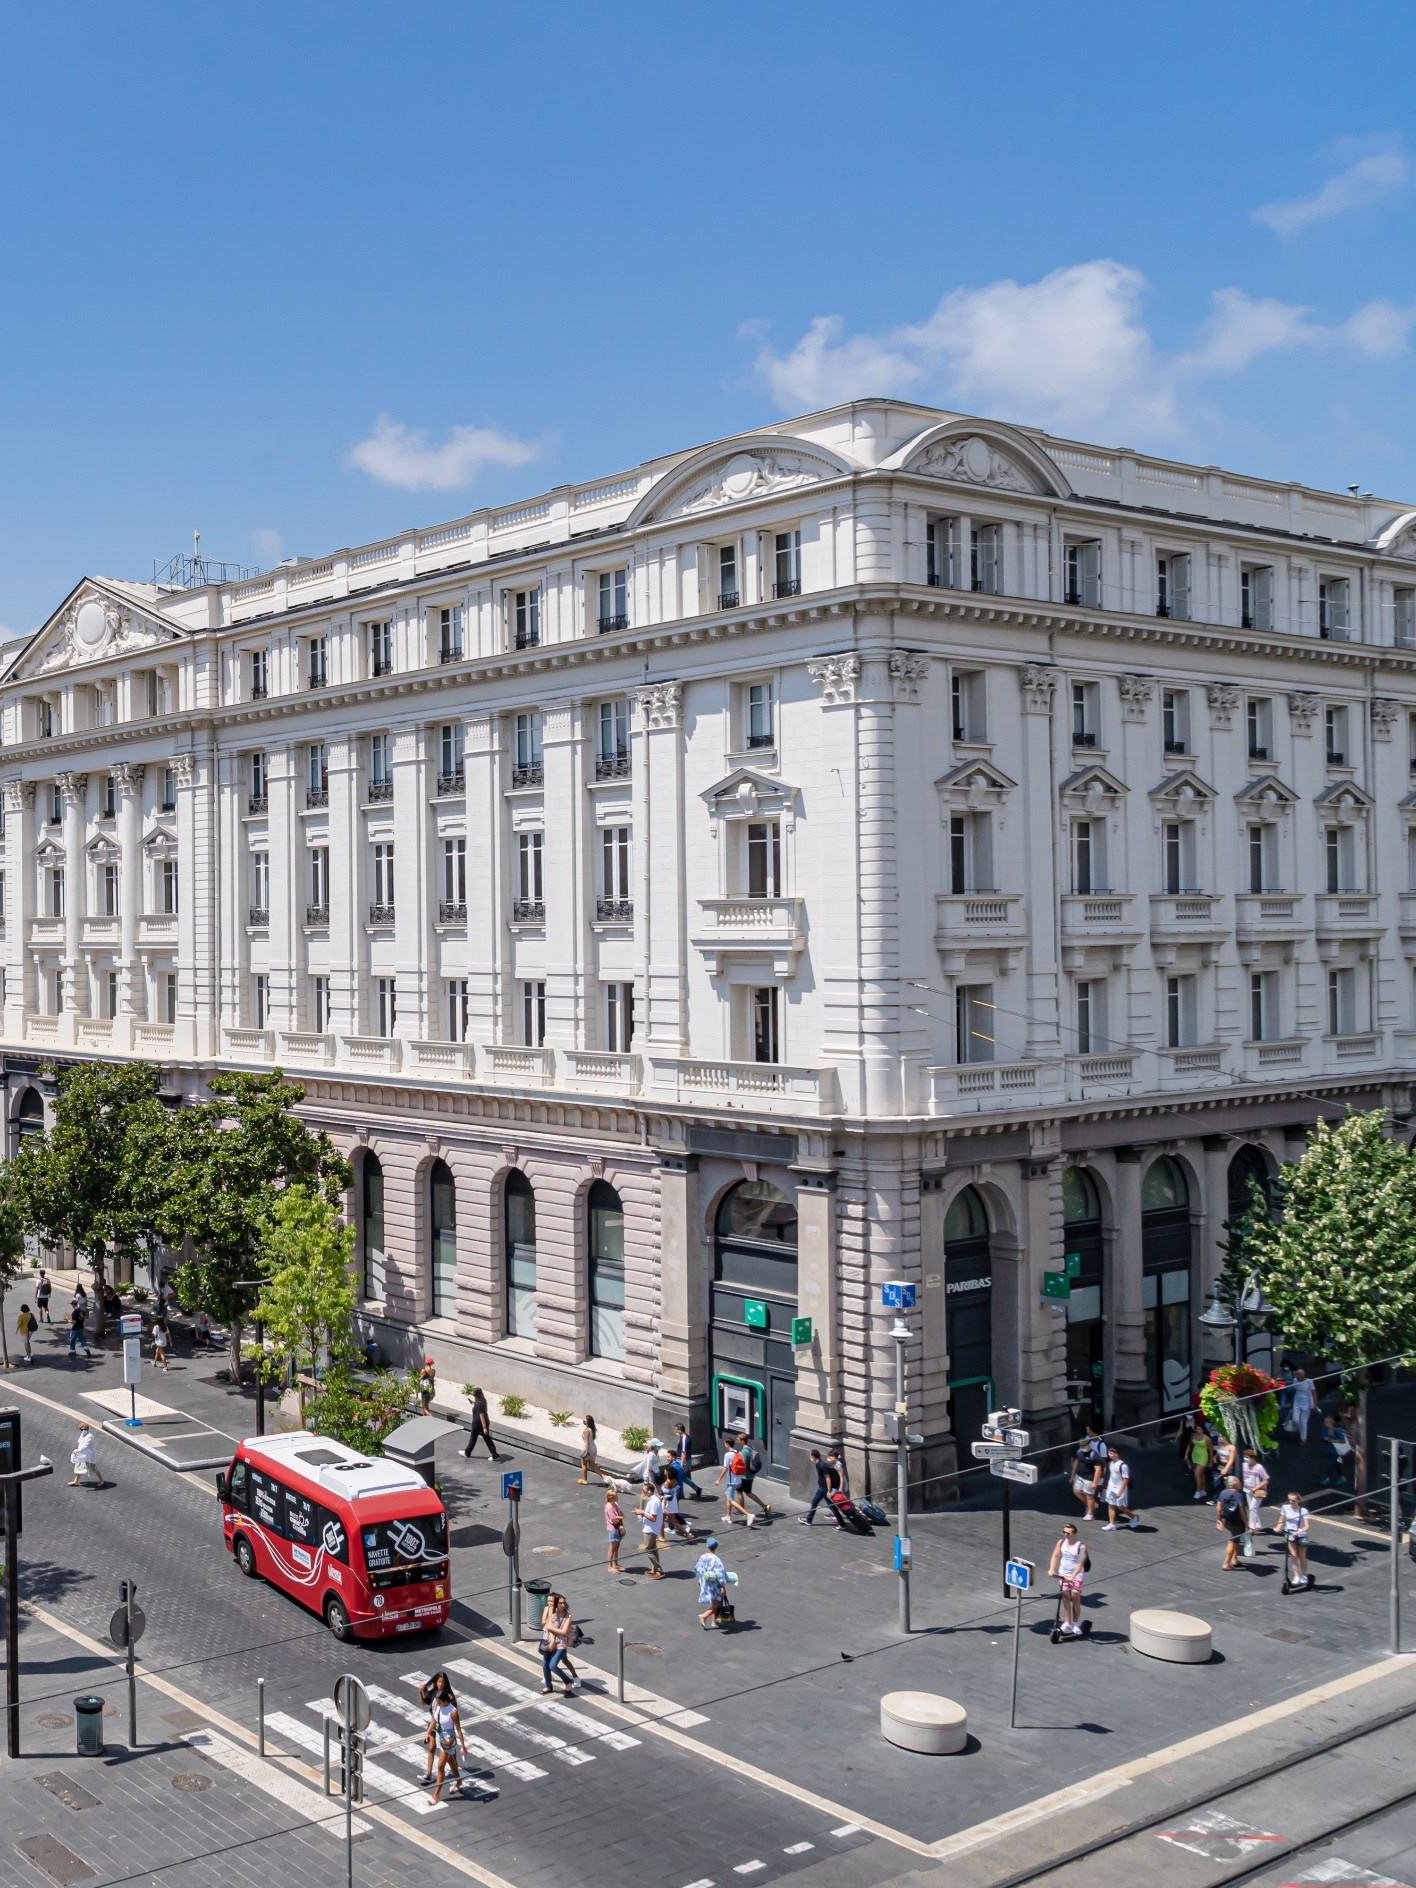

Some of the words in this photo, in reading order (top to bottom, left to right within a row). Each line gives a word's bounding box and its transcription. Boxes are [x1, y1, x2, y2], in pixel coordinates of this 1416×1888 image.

[946, 1277, 992, 1293] PARIBAS
[367, 1548, 389, 1559] NAVETTE
[368, 1556, 391, 1568] GRATUITE
[376, 1596, 383, 1606] 70
